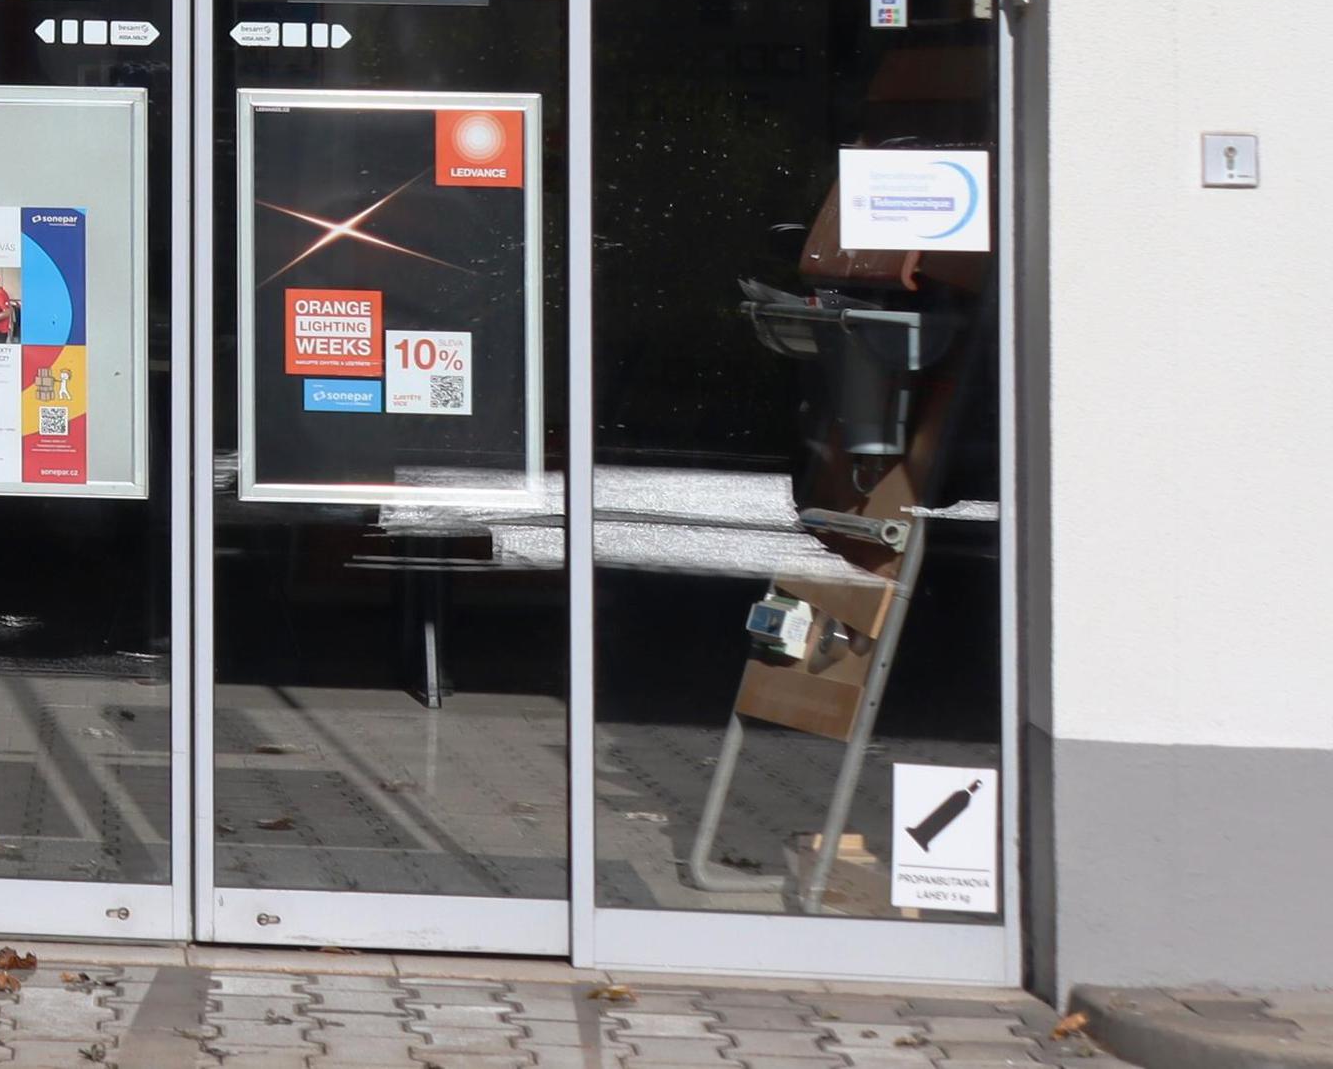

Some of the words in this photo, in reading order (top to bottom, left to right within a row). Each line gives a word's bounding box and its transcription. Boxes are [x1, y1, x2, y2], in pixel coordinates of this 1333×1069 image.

[450, 167, 507, 179] LEDVANCE
[42, 216, 78, 224] sonepar
[0, 242, 16, 252] VÁS
[295, 299, 372, 316] ORANGE
[299, 320, 367, 333] LIGHTING
[295, 337, 372, 356] WEEKS
[327, 391, 373, 402] sonepar
